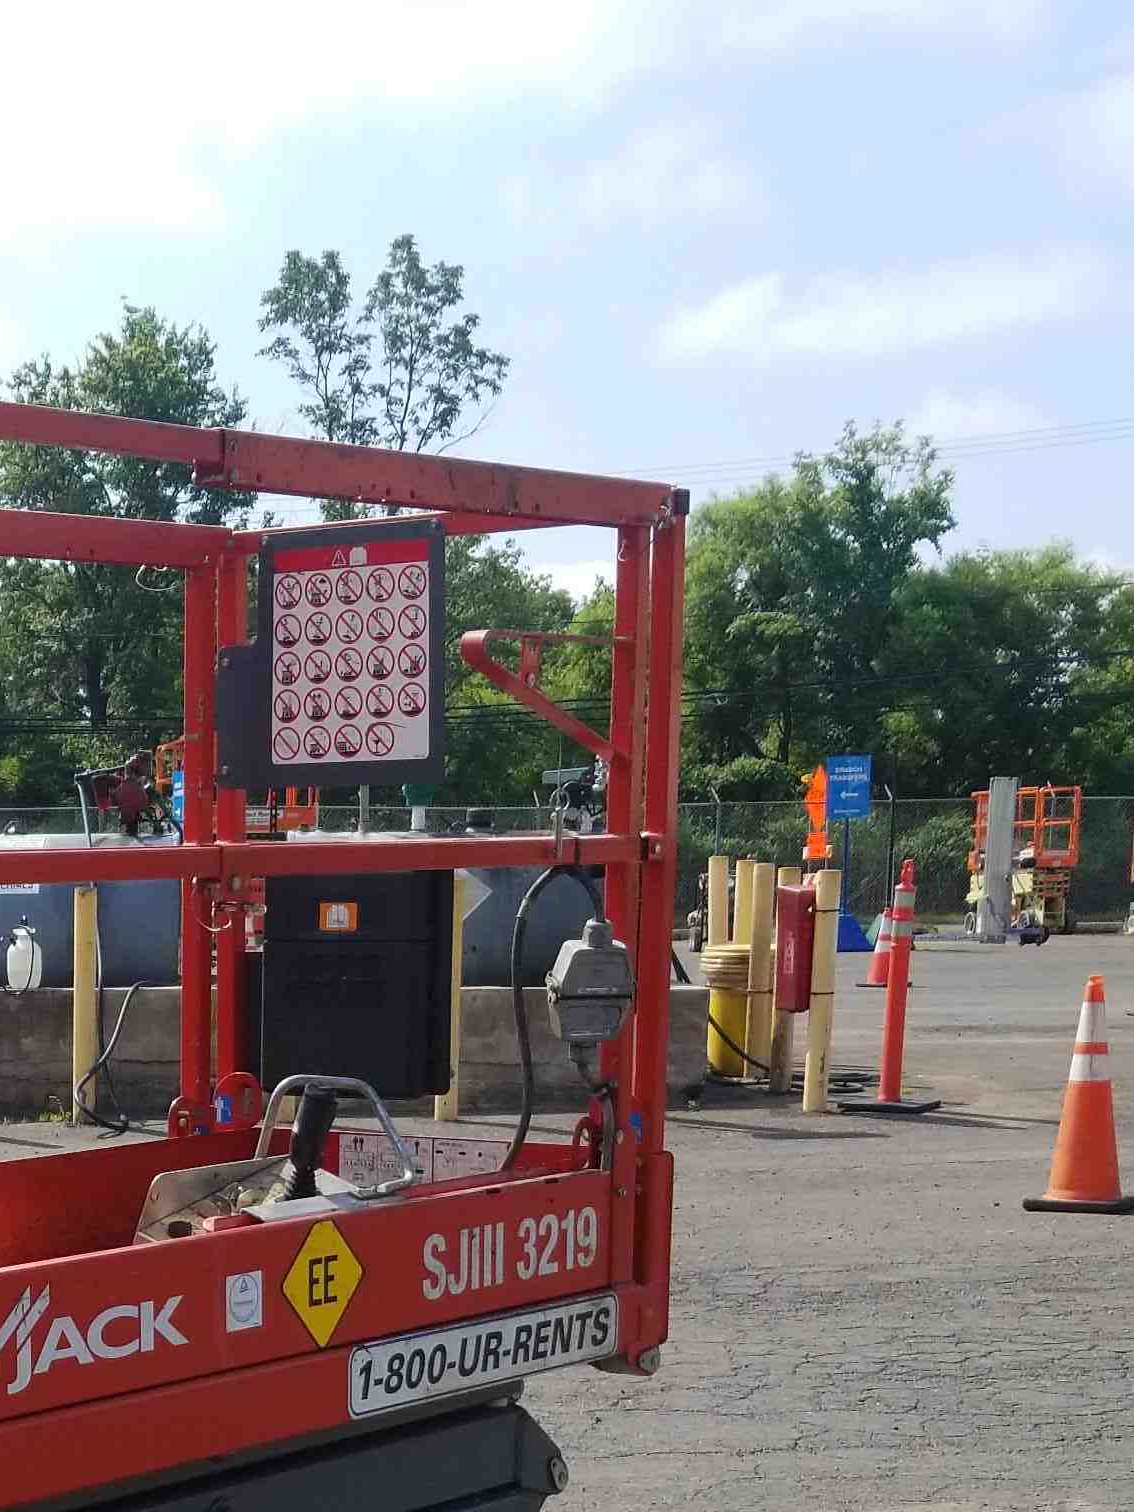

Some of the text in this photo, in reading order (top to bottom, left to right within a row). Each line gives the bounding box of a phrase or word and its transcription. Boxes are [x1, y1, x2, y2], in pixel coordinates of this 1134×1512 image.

[308, 1254, 339, 1308] EE
[516, 1205, 598, 1281] 3219
[358, 1305, 611, 1401] 1-800-UR-RENTS
